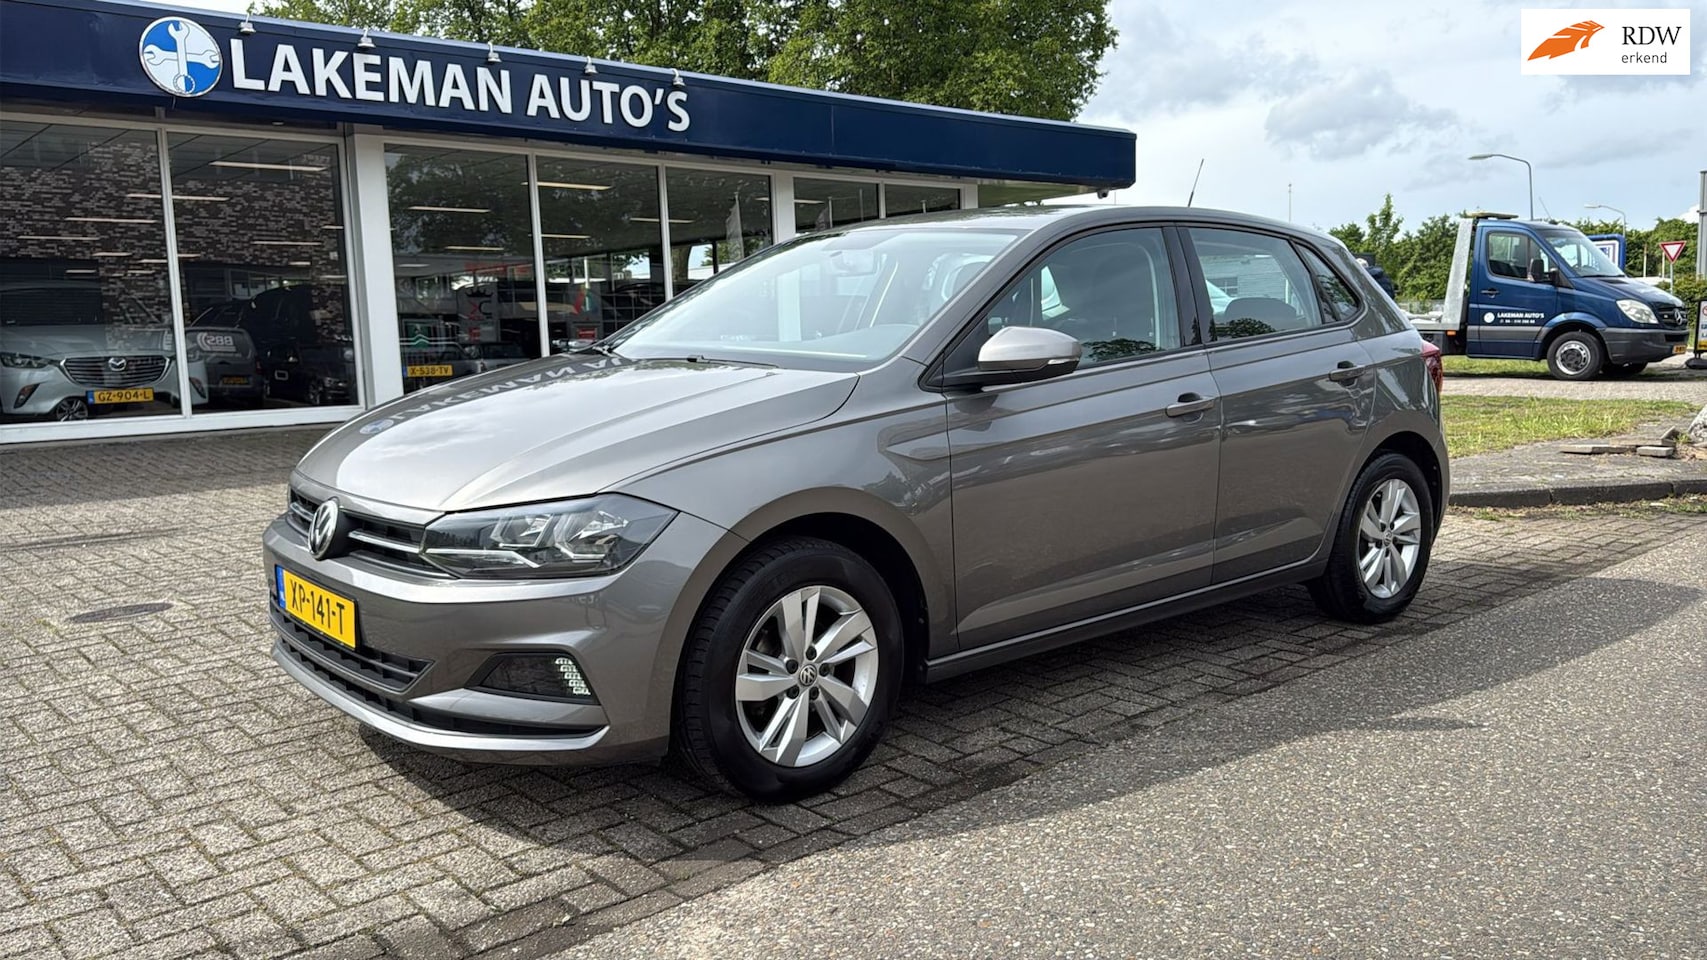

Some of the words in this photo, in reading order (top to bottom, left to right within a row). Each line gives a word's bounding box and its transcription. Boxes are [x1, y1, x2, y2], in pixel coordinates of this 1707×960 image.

[231, 38, 513, 115] LAKEMAN
[526, 74, 691, 132] AUTO'S
[97, 390, 150, 402] GZ-904-L
[290, 579, 345, 635] XP-141-T
